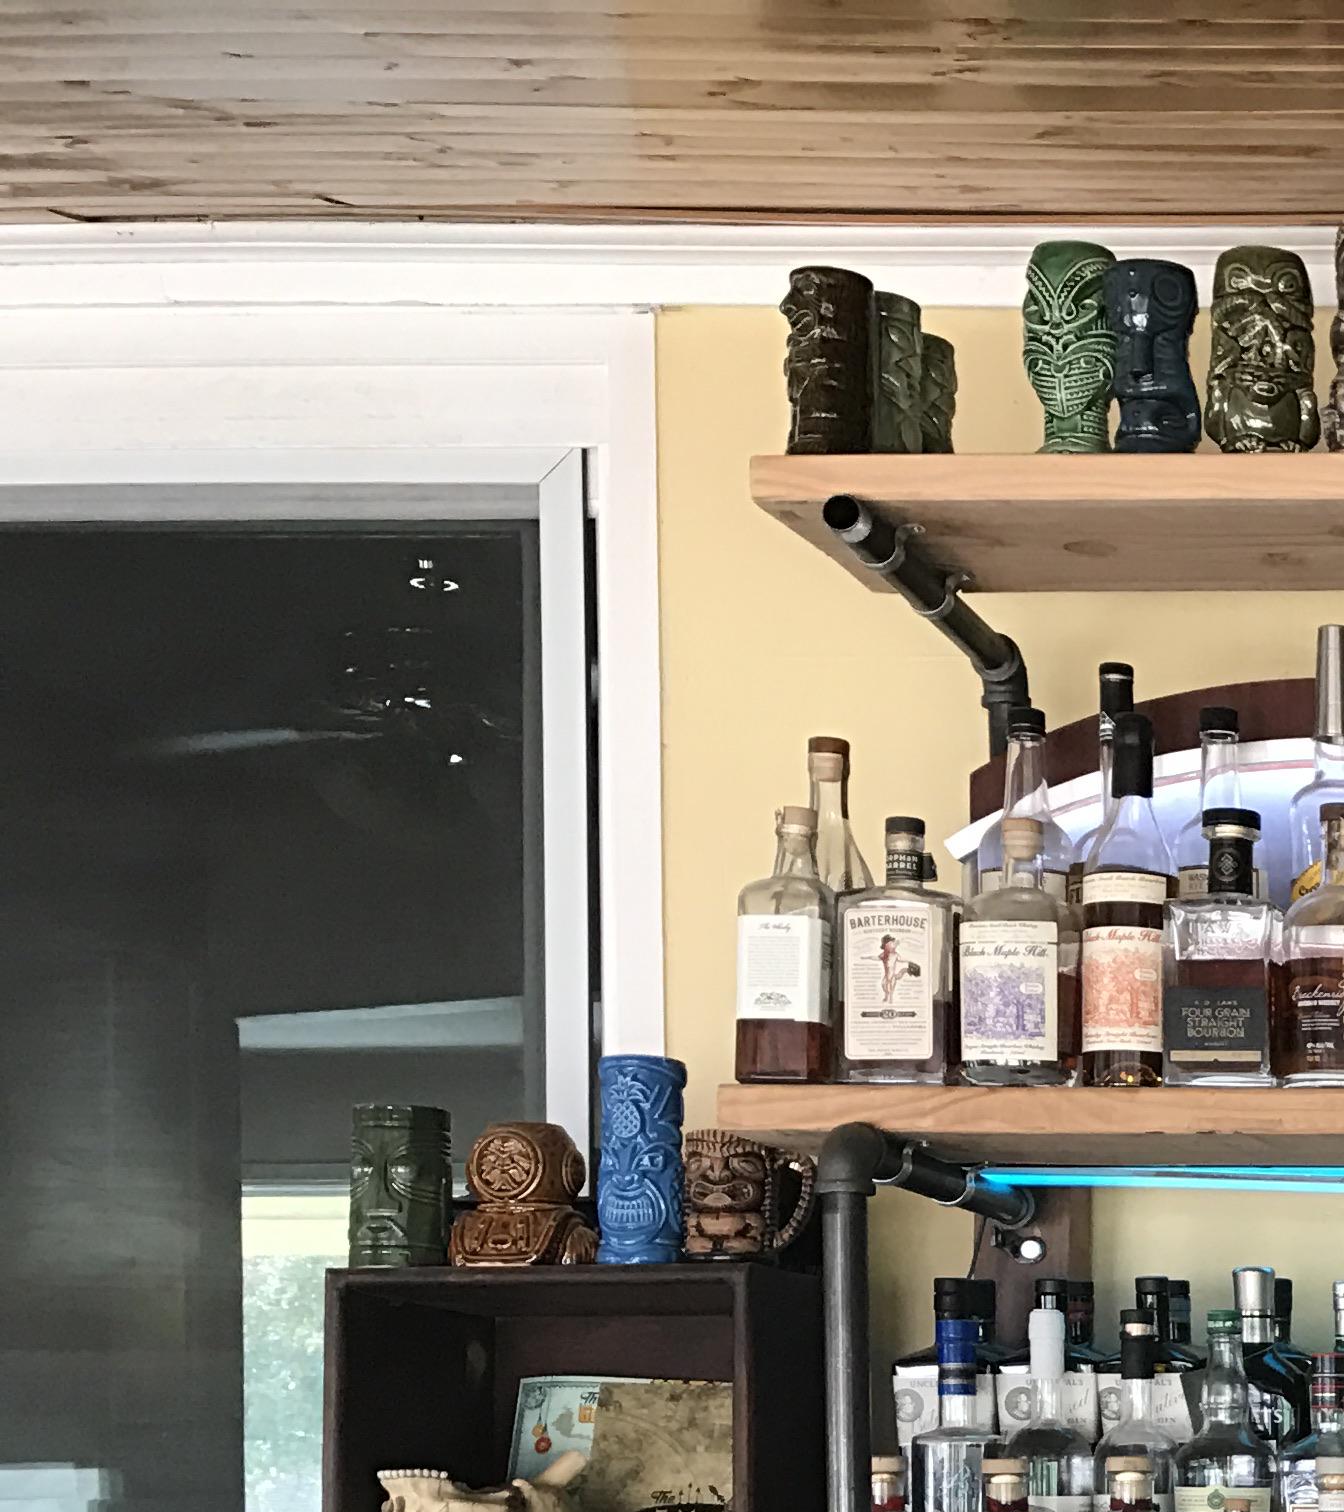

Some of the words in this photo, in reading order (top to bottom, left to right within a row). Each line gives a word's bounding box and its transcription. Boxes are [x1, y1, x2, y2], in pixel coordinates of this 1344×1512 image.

[849, 915, 927, 930] BARTERHOUSE
[1103, 928, 1135, 943] Maple
[1181, 1007, 1212, 1018] FOUR
[1214, 1007, 1250, 1018] GRAIN
[1186, 1017, 1244, 1028] STRAIGHT
[1187, 1027, 1245, 1039] BOURBON
[909, 1379, 937, 1387] UNCL
